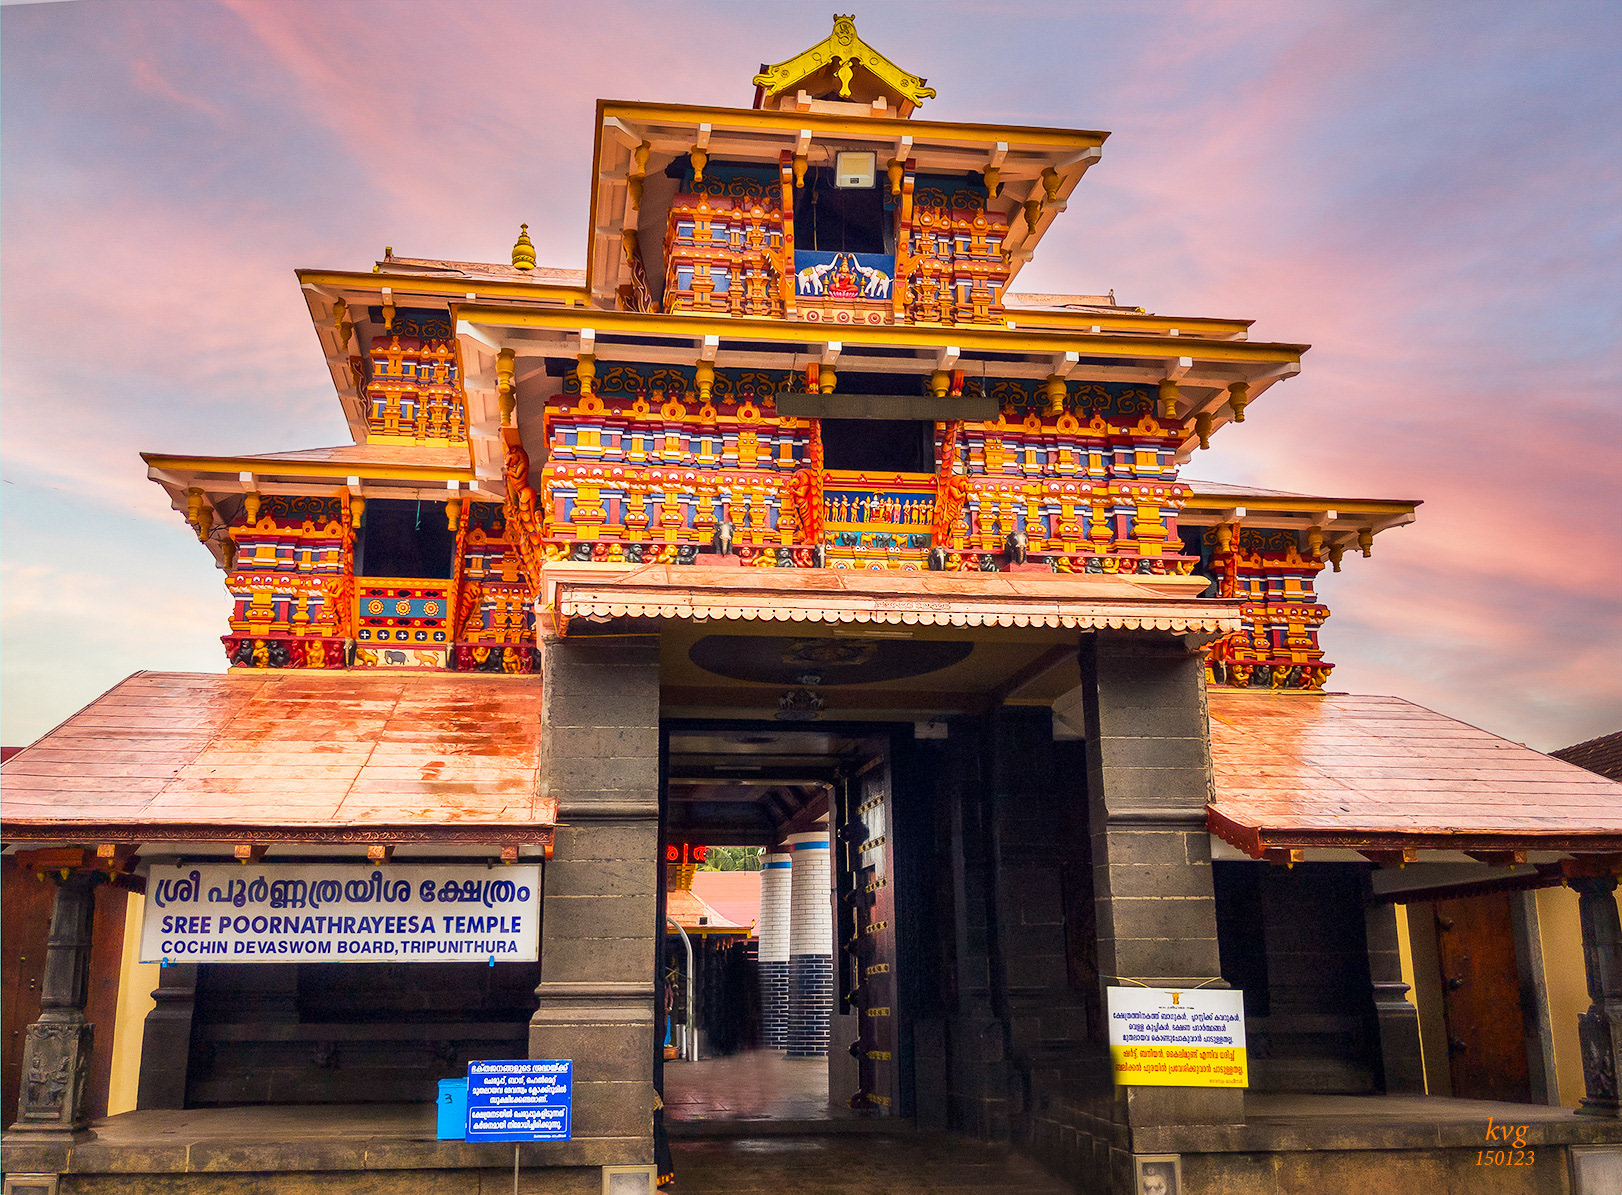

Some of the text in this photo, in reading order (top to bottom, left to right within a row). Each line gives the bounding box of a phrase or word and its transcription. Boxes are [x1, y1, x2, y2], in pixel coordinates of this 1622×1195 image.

[155, 869, 531, 910] ശ്രീ പൂർണ്ണത്രയീശ ക്ഷേത്രം
[160, 915, 522, 934] SREE POORNATHRAYEESA TEMPLE
[160, 940, 228, 954] COCHIN
[233, 940, 332, 954] DEVASWOM
